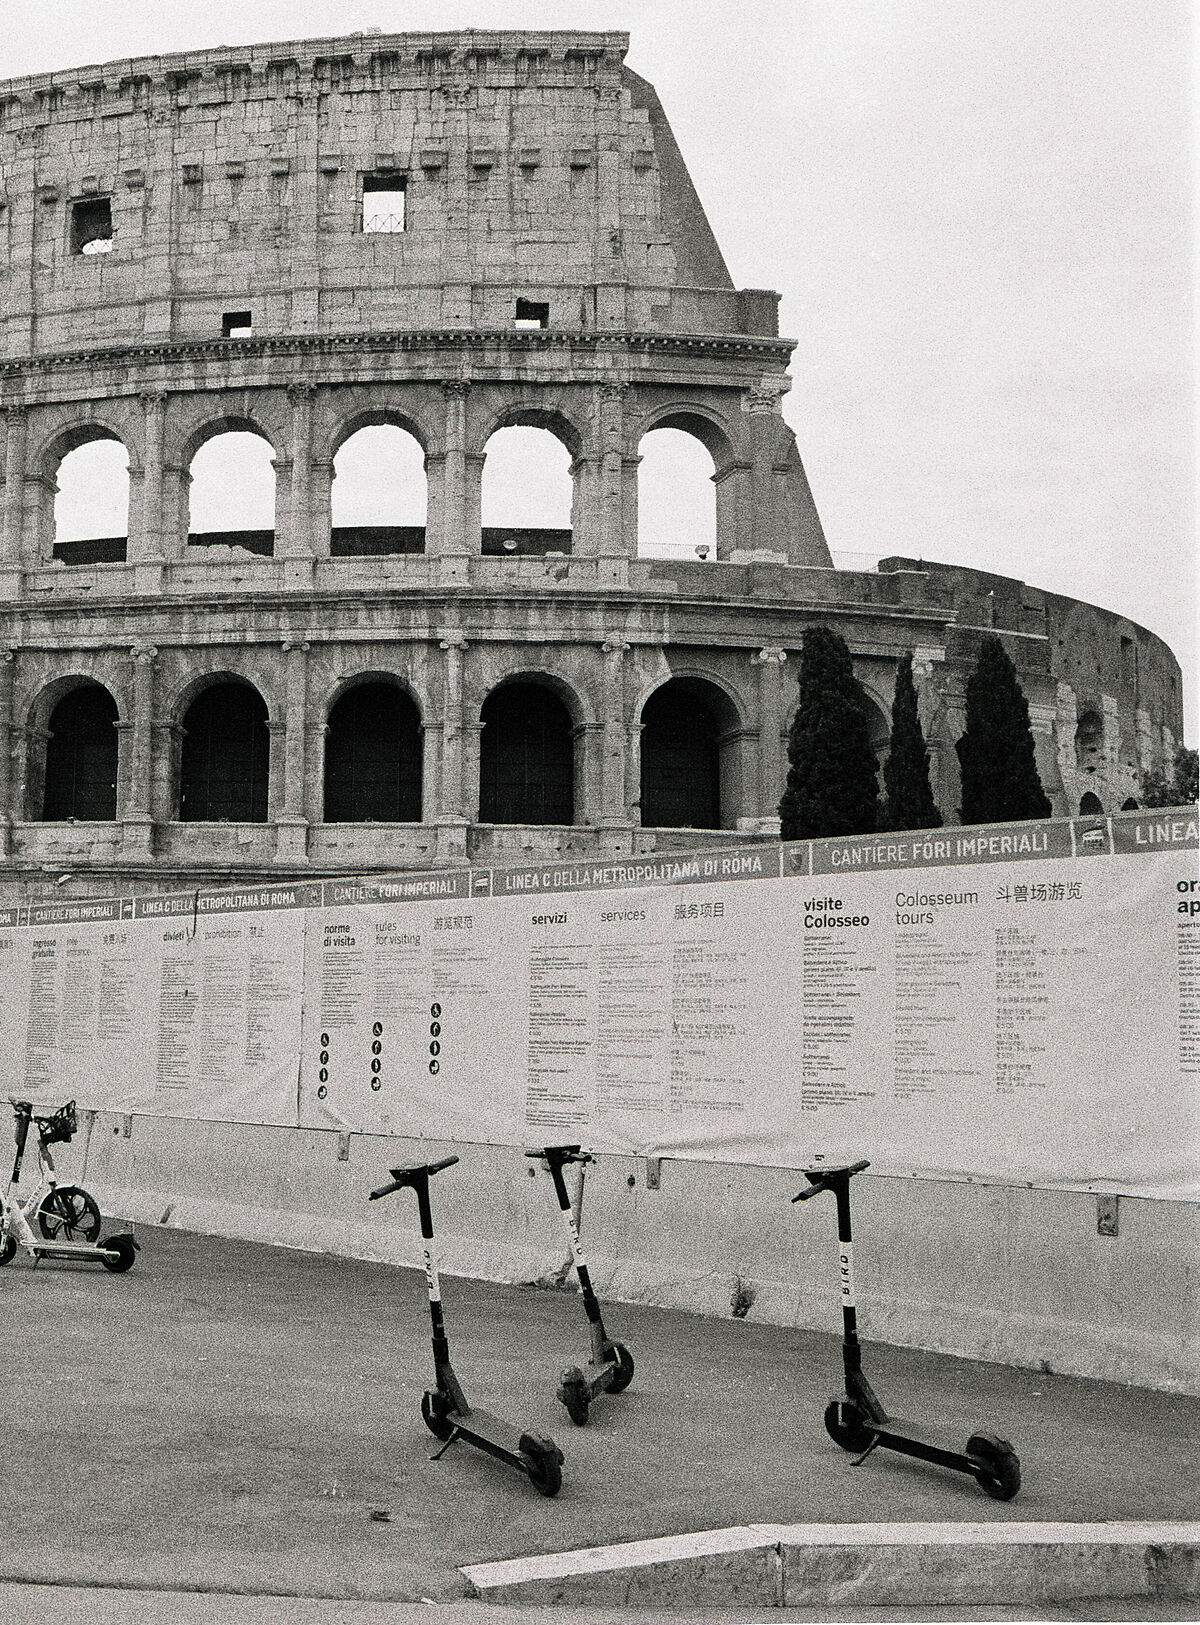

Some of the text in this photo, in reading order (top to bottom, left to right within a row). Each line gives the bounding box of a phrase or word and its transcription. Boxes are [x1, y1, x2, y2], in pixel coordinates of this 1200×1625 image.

[1135, 825, 1199, 845] LINEA
[831, 832, 1049, 867] CANTIERE FORI IMPERIALI
[505, 855, 763, 890] LINEA C DELLA METROPOLITANA DI ROMA
[334, 879, 457, 901] CANTIERE FORI IMPERIALI
[995, 882, 1083, 903] 斗兽场游览
[1176, 880, 1200, 893] or
[142, 902, 164, 914] LINEA
[171, 900, 195, 912] DELLA
[261, 894, 270, 906] DI
[272, 892, 296, 905] ROMA
[803, 897, 843, 913] visite
[895, 889, 980, 908] Colosseum
[531, 912, 568, 926] servizi
[600, 909, 646, 923] services
[674, 902, 725, 920] 服务项目
[895, 909, 934, 926] tours
[323, 923, 350, 935] norme
[375, 921, 397, 932] rules
[804, 912, 870, 929] Colosseo
[163, 931, 185, 942] divieti
[323, 935, 356, 947] di visita
[375, 933, 421, 947] for visiting
[422, 1250, 434, 1290] BIRD
[839, 1254, 850, 1296] BIRD
